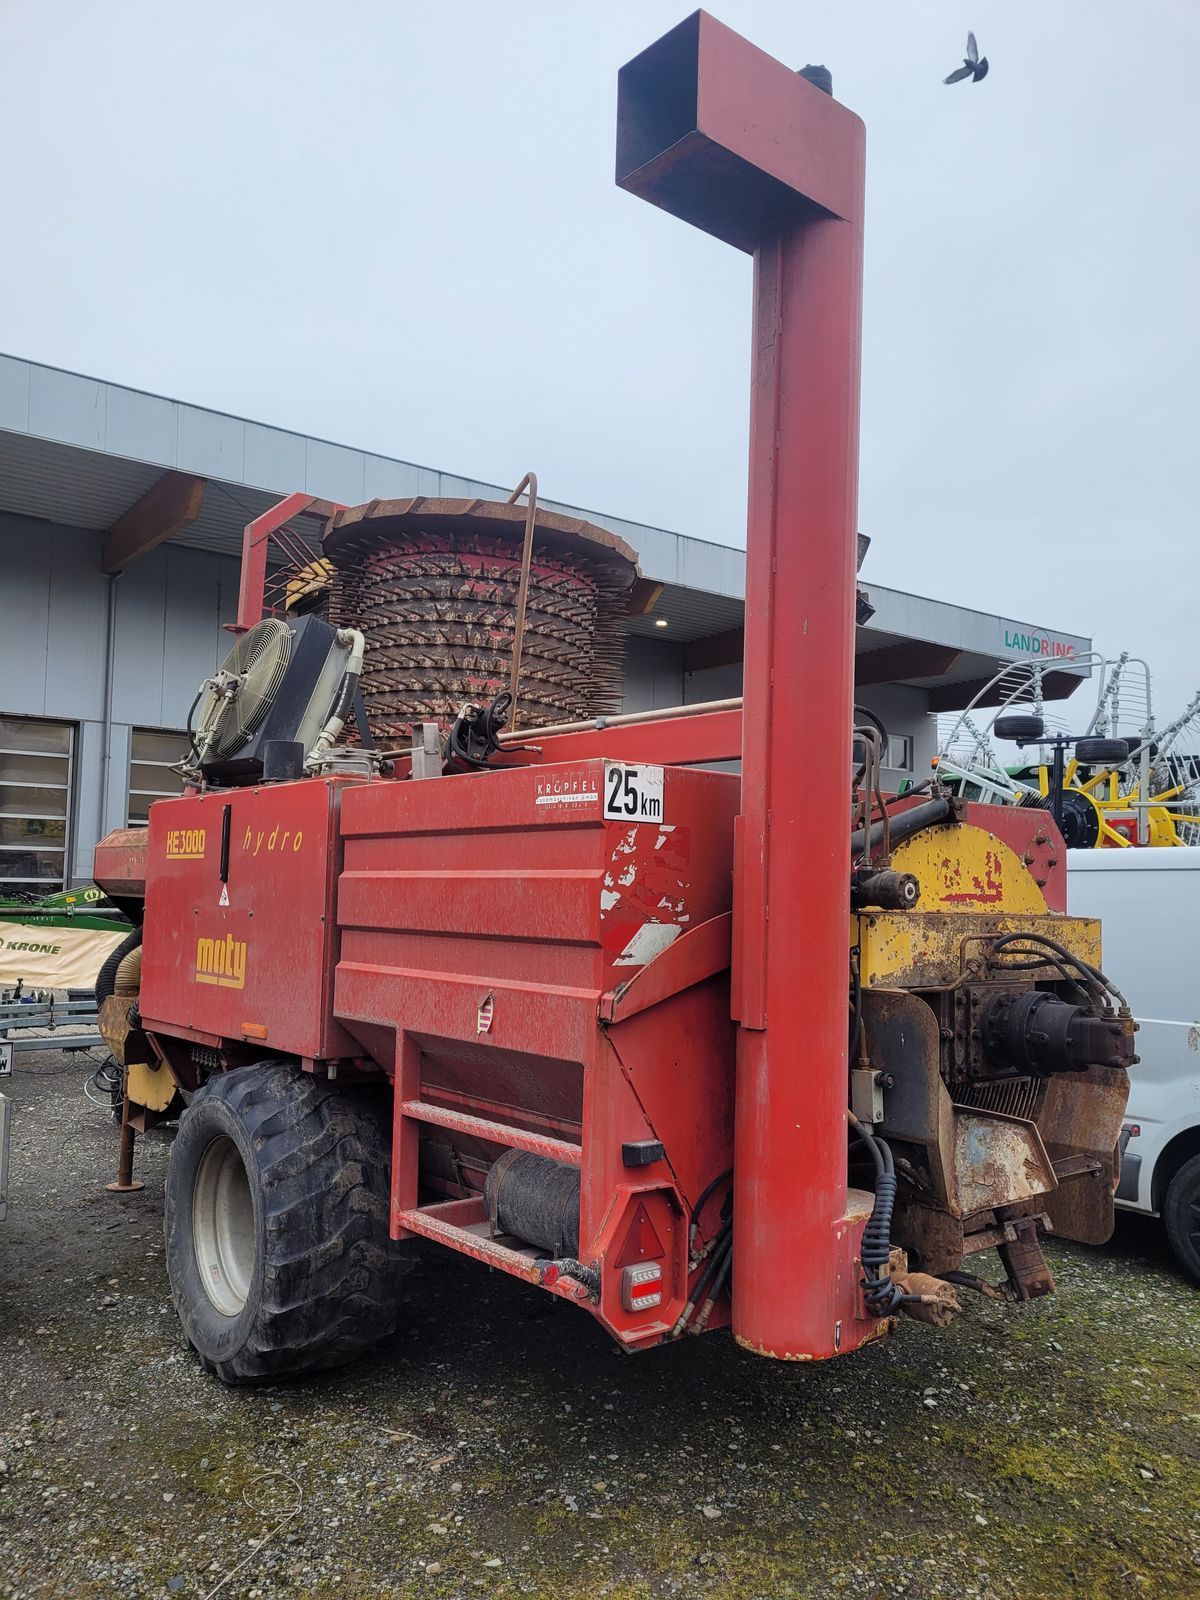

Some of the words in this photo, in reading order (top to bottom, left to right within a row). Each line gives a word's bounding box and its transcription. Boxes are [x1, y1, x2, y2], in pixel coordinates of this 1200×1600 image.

[607, 767, 639, 815] 25
[641, 791, 661, 817] km
[243, 824, 303, 857] hydro
[6, 941, 62, 955] KRONE
